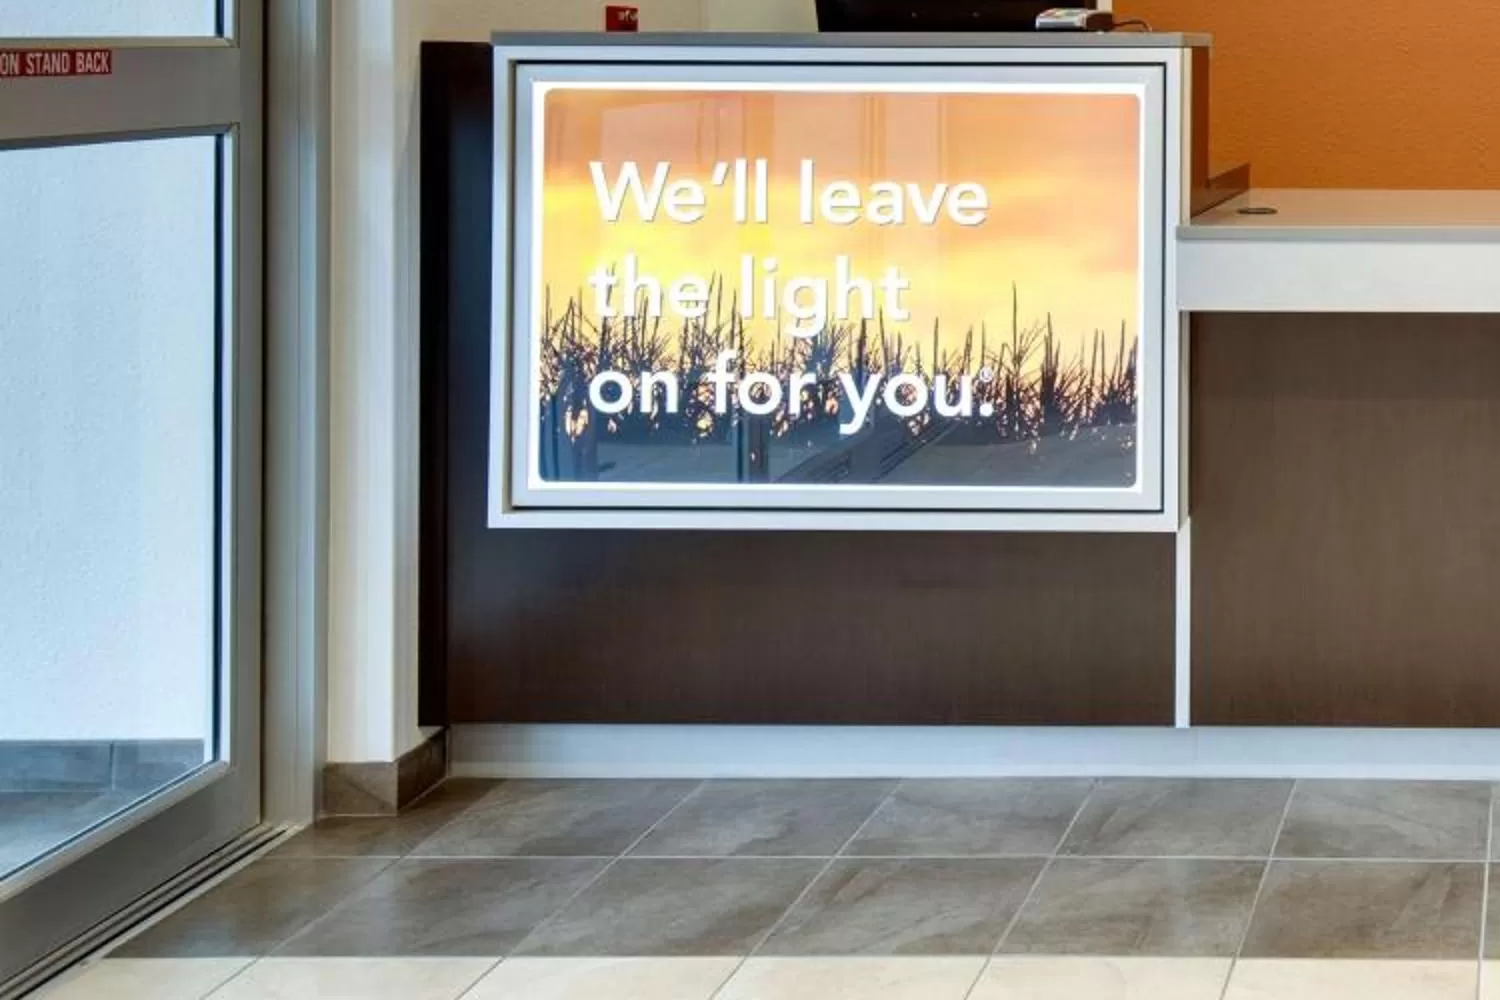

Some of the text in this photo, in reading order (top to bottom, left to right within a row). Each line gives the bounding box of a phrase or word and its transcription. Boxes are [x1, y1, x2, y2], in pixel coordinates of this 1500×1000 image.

[25, 52, 70, 74] STAND
[75, 51, 109, 73] BACK
[588, 158, 989, 226] We'll leave
[588, 250, 912, 338] the light
[589, 364, 678, 415] on
[710, 350, 819, 416] for
